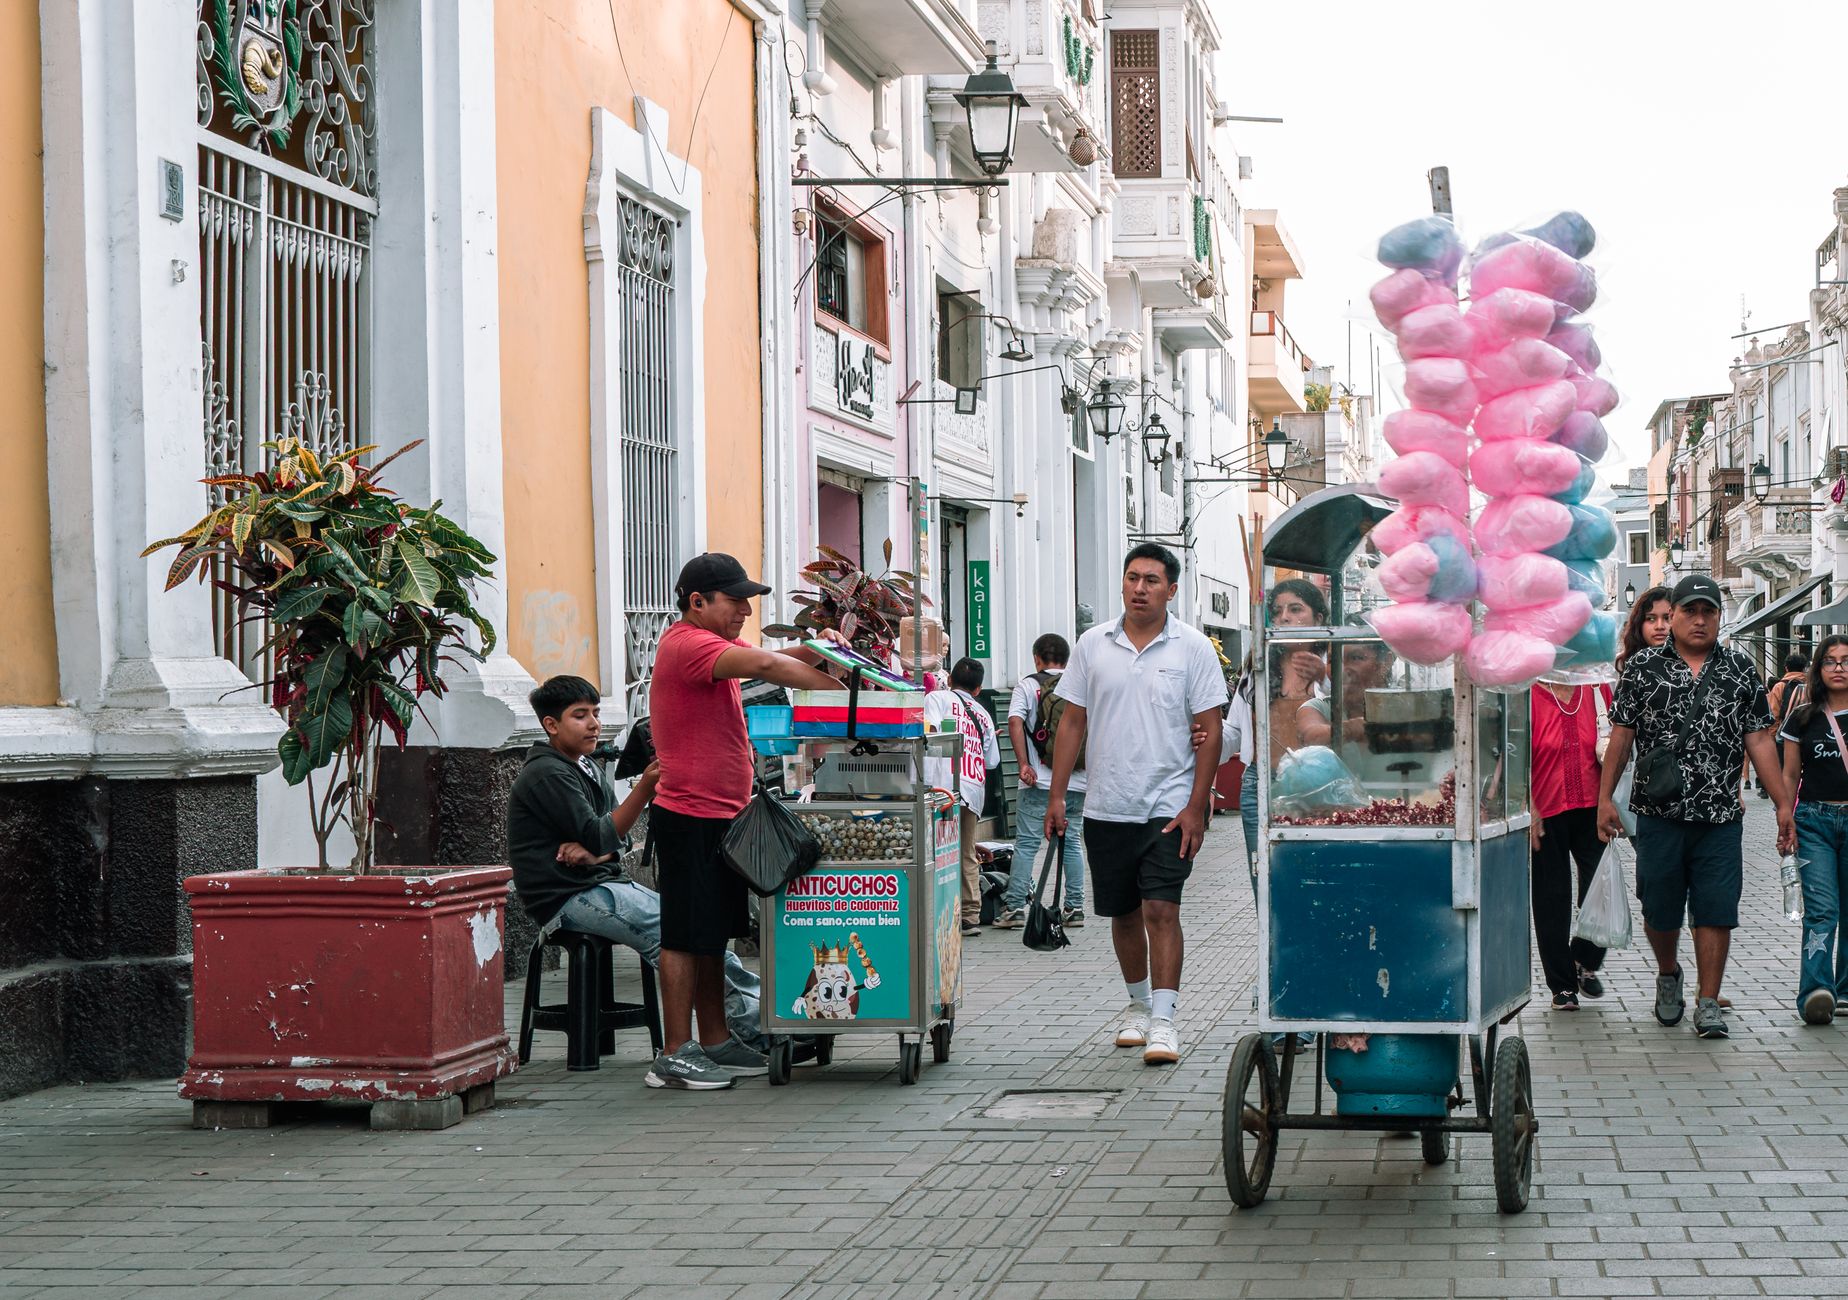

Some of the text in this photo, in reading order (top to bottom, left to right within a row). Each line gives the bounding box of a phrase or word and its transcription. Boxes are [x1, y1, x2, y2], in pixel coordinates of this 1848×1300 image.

[973, 568, 986, 651] kaita
[786, 875, 898, 896] ANTICUCHOS
[786, 899, 831, 911] Huevitos
[834, 899, 848, 911] de
[783, 914, 813, 926] Coma
[878, 913, 901, 926] bien
